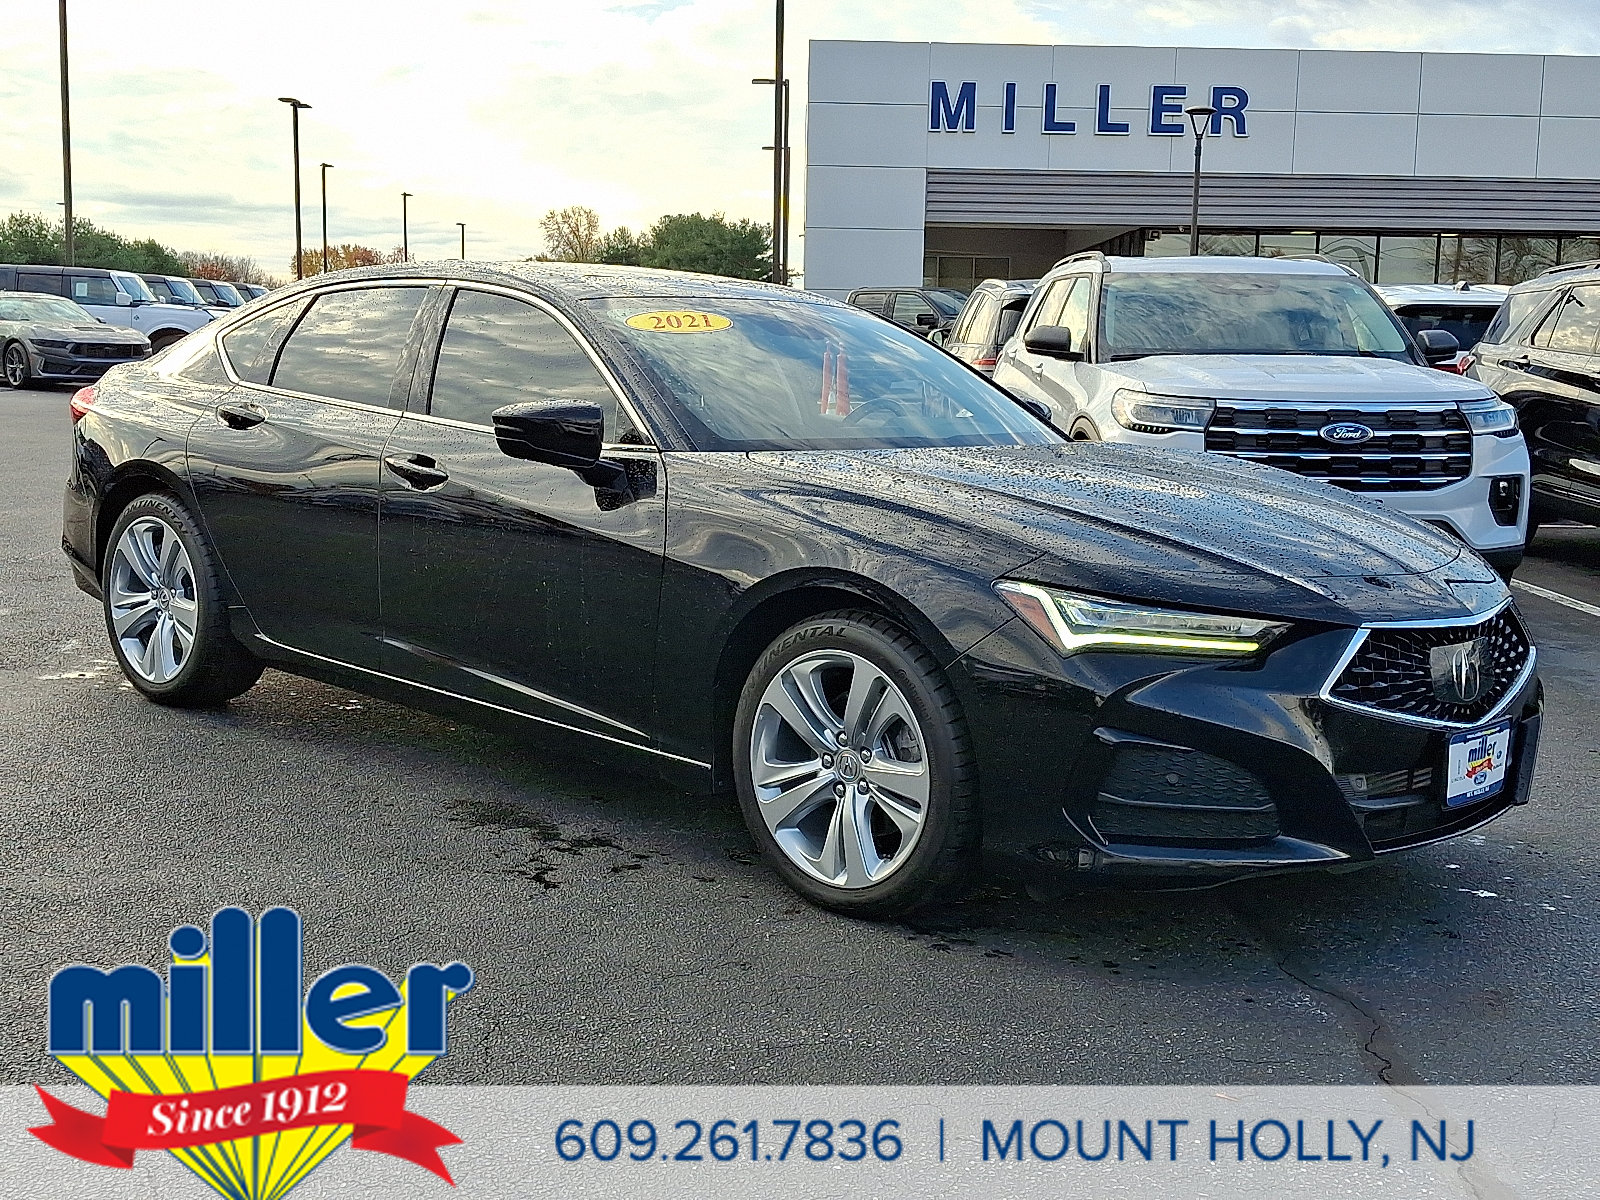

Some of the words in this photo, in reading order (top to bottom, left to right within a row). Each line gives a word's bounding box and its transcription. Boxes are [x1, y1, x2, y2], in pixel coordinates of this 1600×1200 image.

[928, 80, 1250, 137] MILLER
[648, 313, 715, 330] 2021
[1332, 426, 1362, 439] Ford
[119, 499, 190, 535] ONTINENTAL
[1467, 735, 1498, 763] miller
